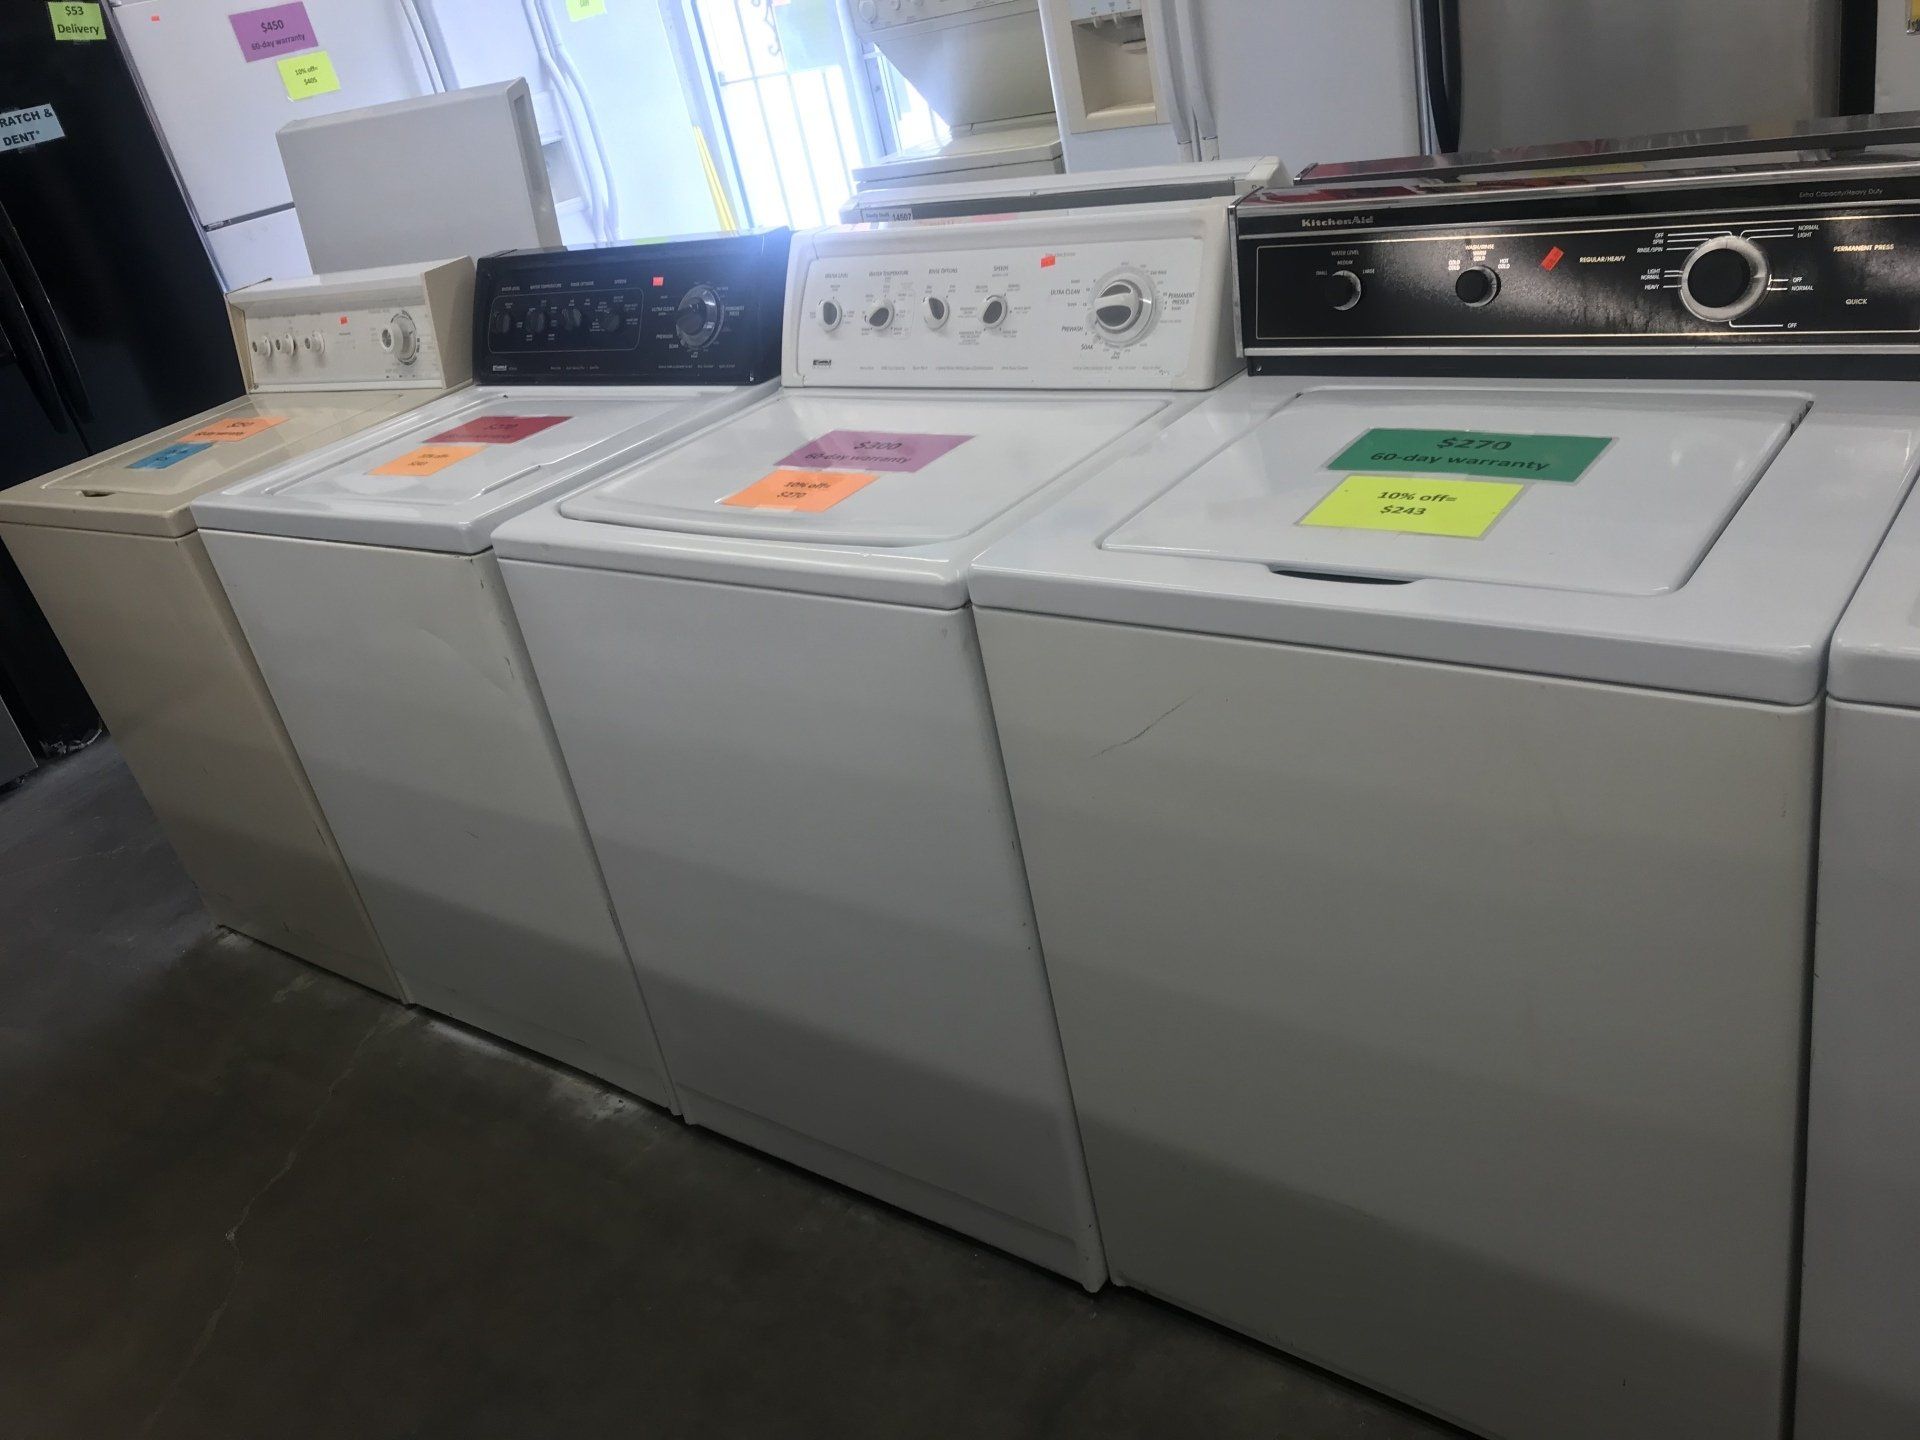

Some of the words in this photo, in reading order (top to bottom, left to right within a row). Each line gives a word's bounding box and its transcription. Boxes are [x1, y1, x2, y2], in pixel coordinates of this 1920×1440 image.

[57, 23, 99, 36] Delivery
[260, 19, 284, 34] $450
[251, 40, 275, 51] 60-day
[275, 33, 305, 46] warranty
[44, 108, 53, 118] &
[1301, 215, 1374, 227] KitchenAid
[1833, 244, 1873, 252] PERMANENT
[1874, 243, 1895, 251] PRESS
[1579, 255, 1626, 263] REGULAR/HEAVY
[1436, 437, 1513, 451] $270
[849, 455, 913, 464] warranty
[1370, 452, 1443, 464] 60-day
[1447, 455, 1552, 472] warranty
[1377, 491, 1417, 501] 10%
[1380, 504, 1427, 515] $243
